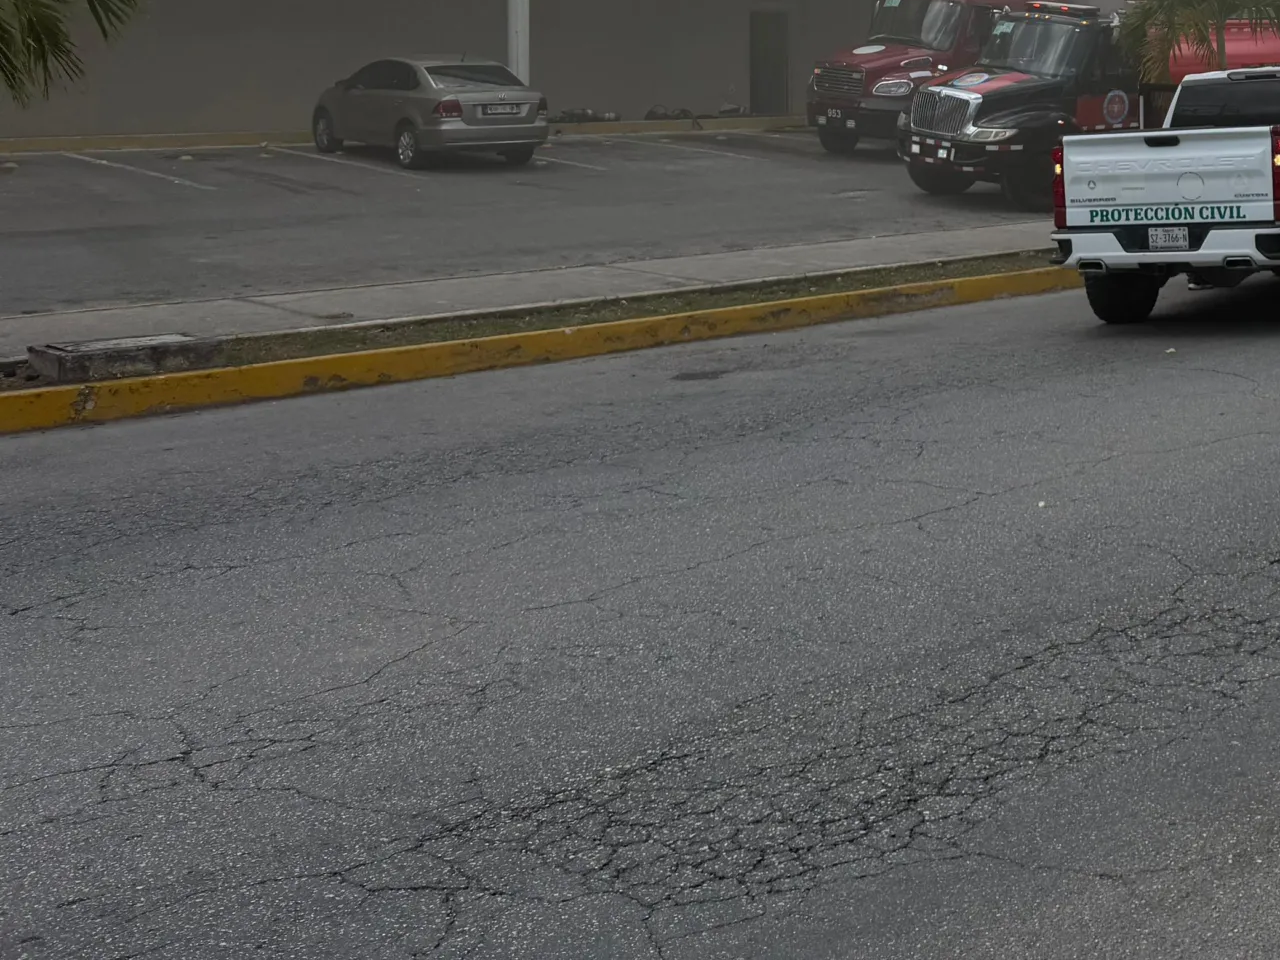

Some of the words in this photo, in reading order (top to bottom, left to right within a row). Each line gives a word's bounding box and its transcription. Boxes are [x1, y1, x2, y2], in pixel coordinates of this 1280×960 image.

[827, 108, 842, 118] 953
[1076, 155, 1255, 173] CHEVROLET
[1089, 204, 1195, 223] PROTECCIÓN
[1199, 206, 1246, 220] CIVIL
